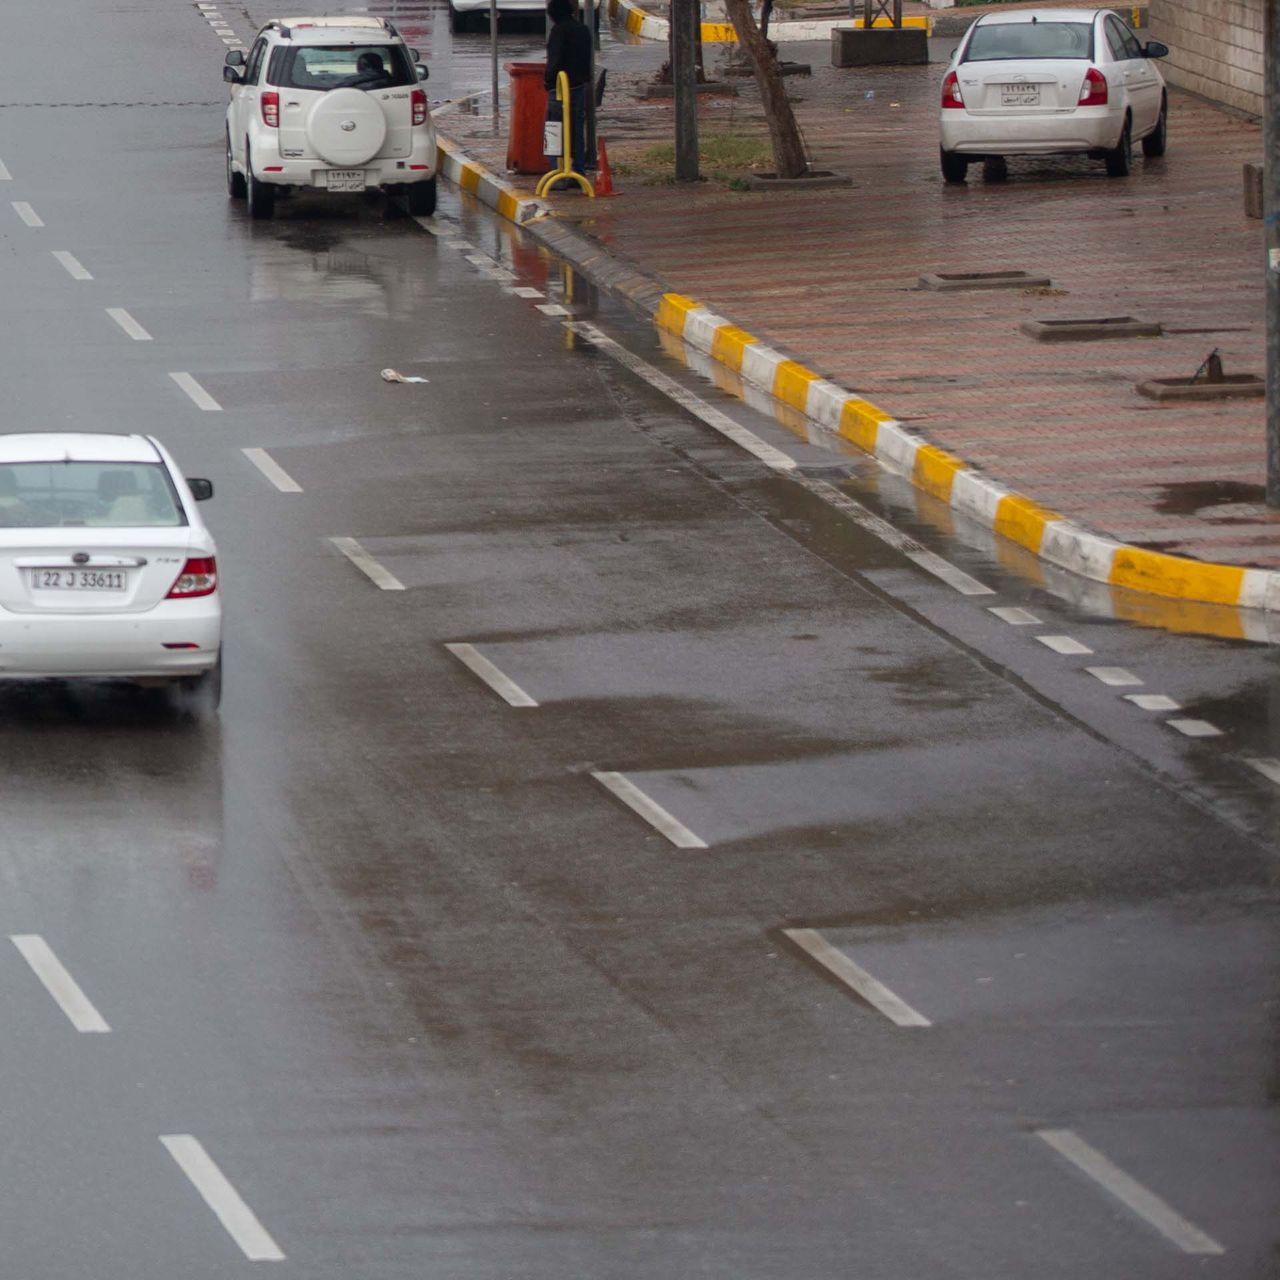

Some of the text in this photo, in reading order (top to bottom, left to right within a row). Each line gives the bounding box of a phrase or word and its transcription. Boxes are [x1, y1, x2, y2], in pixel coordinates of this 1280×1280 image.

[43, 571, 123, 588] 22 J 33611
